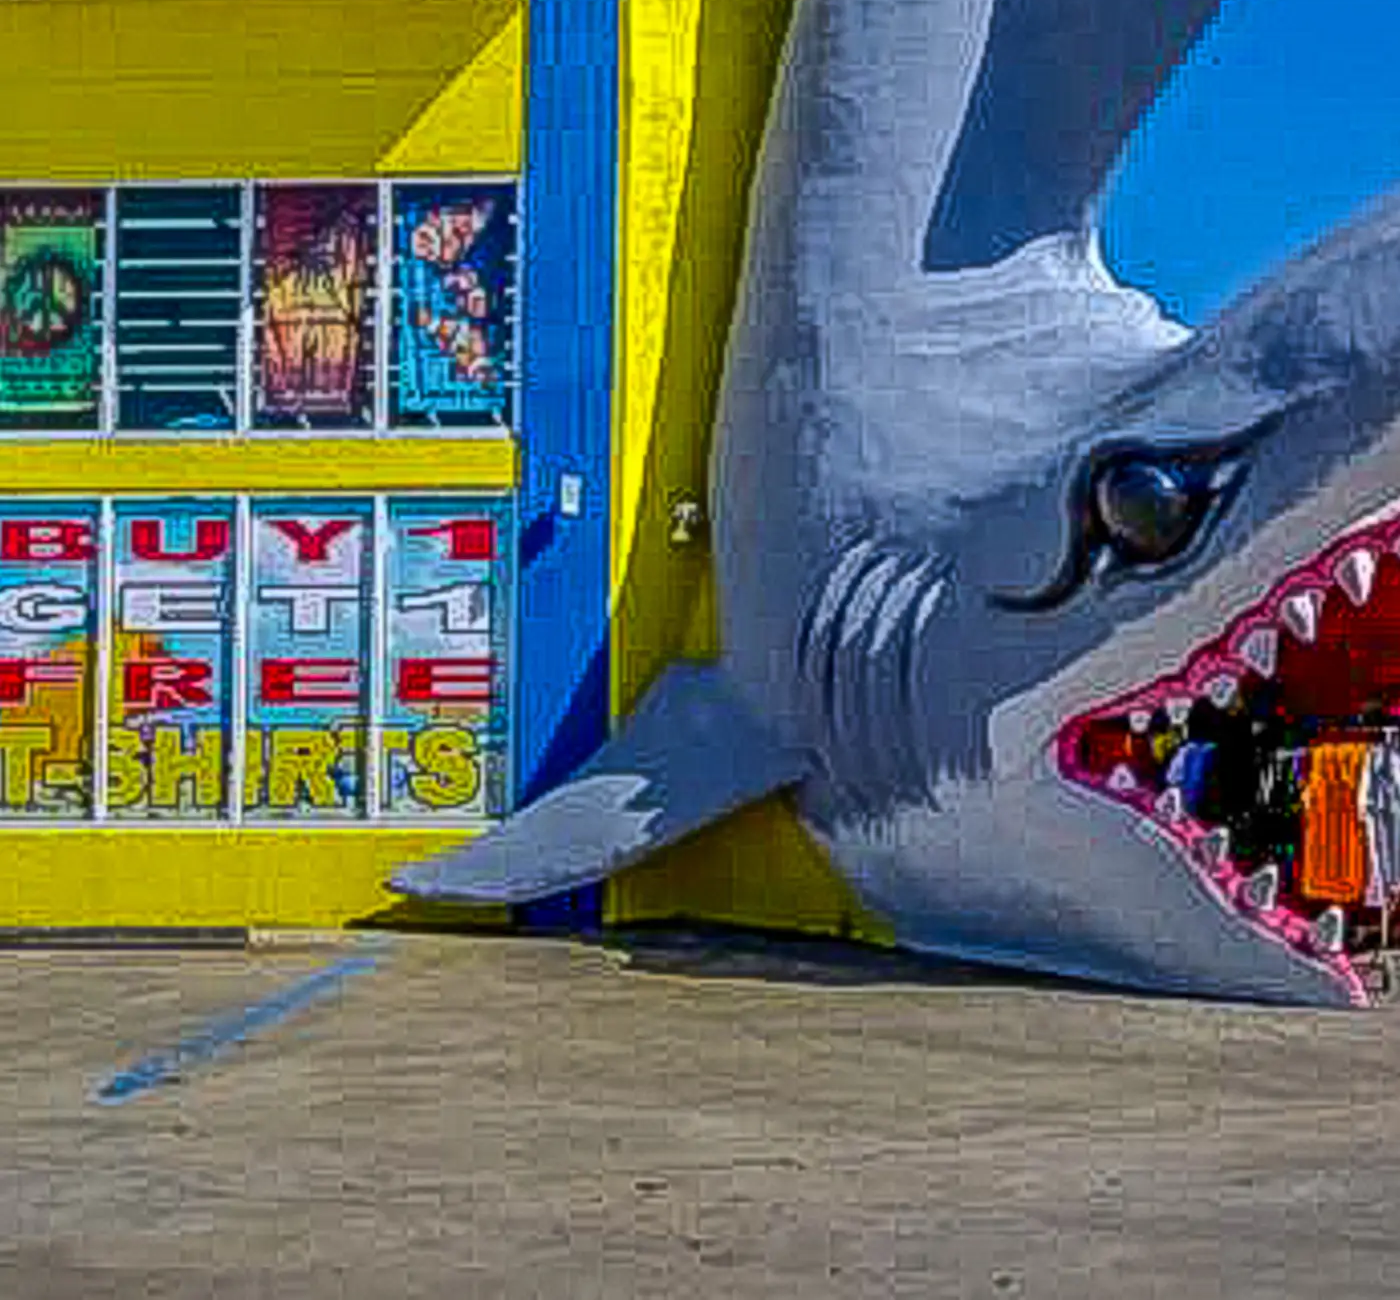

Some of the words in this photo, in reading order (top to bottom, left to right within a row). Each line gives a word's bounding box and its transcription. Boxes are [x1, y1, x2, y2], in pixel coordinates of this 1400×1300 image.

[1, 519, 359, 561] BUY
[407, 520, 495, 560] 1
[0, 583, 361, 632] GET
[400, 584, 494, 633] 1
[0, 659, 493, 704] FREE
